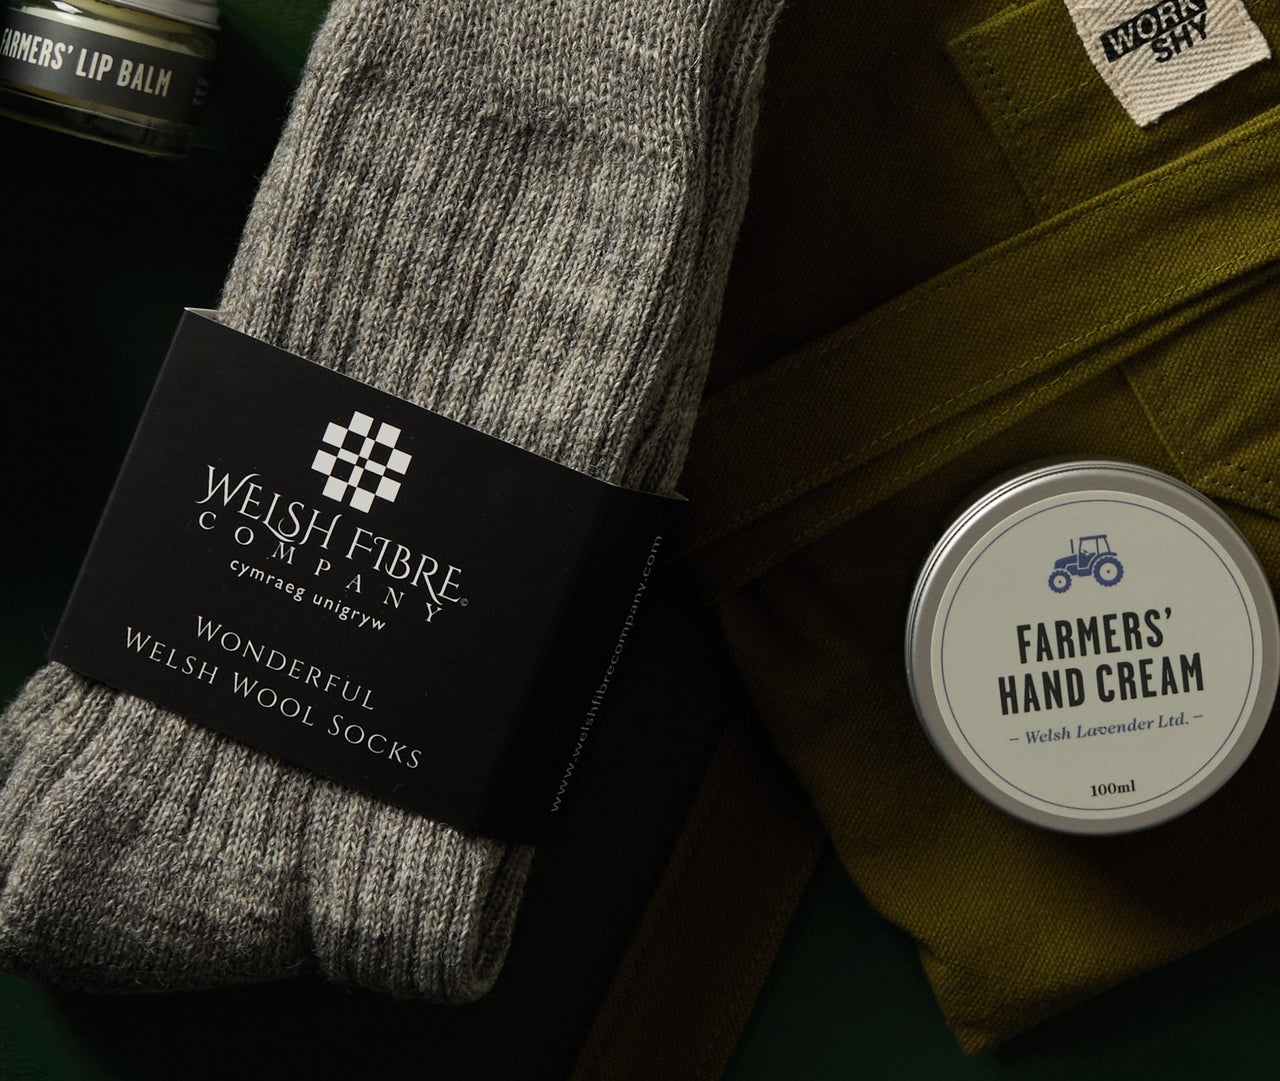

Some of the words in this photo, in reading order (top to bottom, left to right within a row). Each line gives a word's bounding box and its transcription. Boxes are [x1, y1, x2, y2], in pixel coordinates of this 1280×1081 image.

[75, 48, 114, 82] LIP
[116, 59, 173, 97] BALM
[1151, 13, 1208, 63] SHY
[194, 464, 343, 550] WELSH
[198, 511, 443, 623] COMPANY
[230, 559, 306, 603] cymraeg
[312, 593, 386, 631] unigryw
[125, 626, 219, 685] WELSH
[232, 671, 316, 727] WOOL
[327, 713, 422, 770] SOCKS
[196, 615, 375, 710] WONDERFUL
[550, 535, 663, 813] www.welshfibrecompany.com
[998, 667, 1086, 716] HAND
[1096, 652, 1205, 704] CREAM
[1025, 726, 1071, 745] Welsh
[1076, 718, 1154, 739] Lavender
[1158, 712, 1189, 729] Ltd.
[1090, 780, 1136, 797] 100ml
